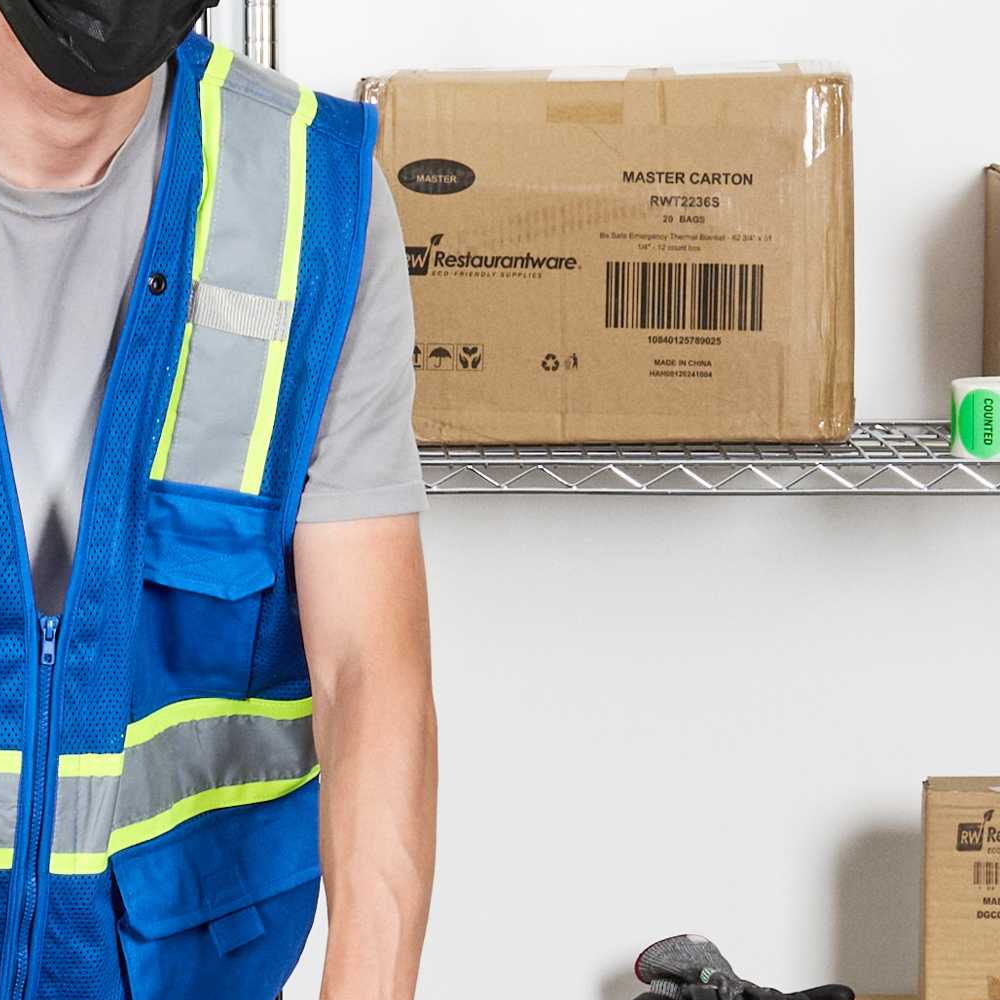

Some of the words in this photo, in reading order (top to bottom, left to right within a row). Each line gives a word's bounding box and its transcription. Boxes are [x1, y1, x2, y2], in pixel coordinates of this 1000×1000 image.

[416, 174, 457, 184] MASTER
[623, 171, 685, 184] MASTER
[690, 172, 754, 186] CARTON
[650, 195, 720, 208] RWT2236S
[663, 215, 674, 224] 20
[679, 215, 706, 224] BAGS
[434, 251, 577, 270] Restaurantware
[432, 270, 497, 278] ECO-FRIENDLY
[500, 271, 542, 279] SUPPLIES
[654, 359, 677, 367] MADE
[983, 398, 993, 446] COUNTED
[961, 830, 981, 845] RW
